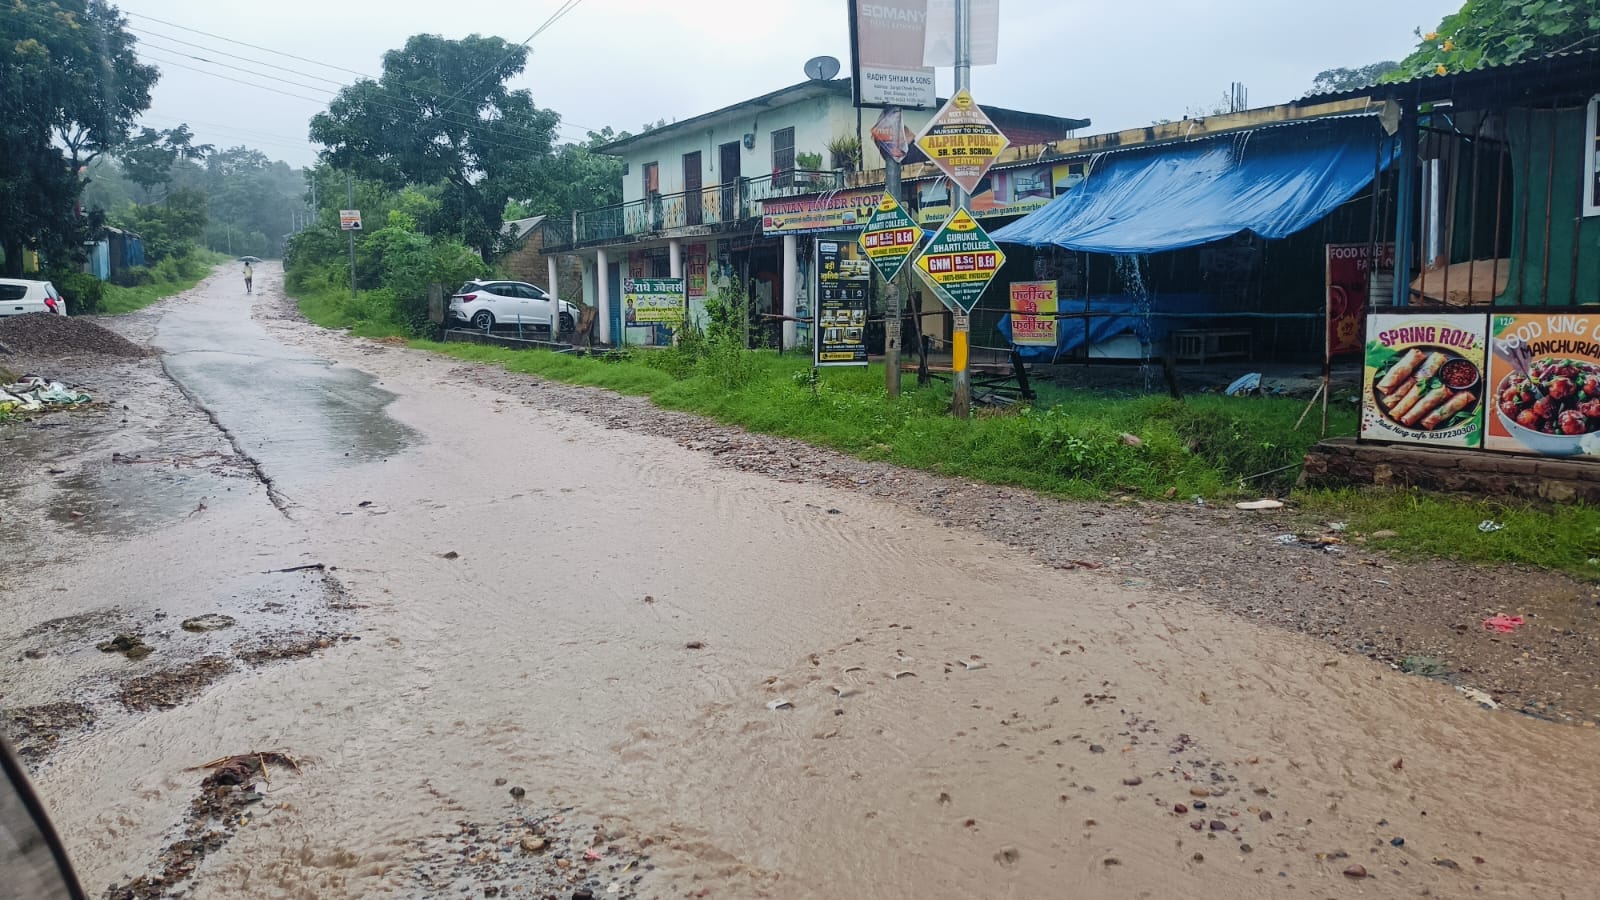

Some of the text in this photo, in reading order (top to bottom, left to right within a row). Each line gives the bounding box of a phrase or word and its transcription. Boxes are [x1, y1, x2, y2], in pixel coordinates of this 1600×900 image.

[862, 4, 927, 21] SOMANY
[866, 73, 887, 81] RADHY
[928, 135, 999, 148] ALPHA PUBLIC
[969, 147, 992, 155] SCHOOL
[763, 203, 804, 216] DHIMAN
[808, 199, 848, 211] TIMBER
[987, 207, 998, 215] with
[885, 219, 908, 228] COLLEGE
[897, 232, 912, 243] B.Ed
[946, 233, 978, 242] GURUKUL
[934, 241, 991, 253] BHARTI COLLEGE
[1331, 248, 1358, 258] FOOD
[930, 256, 995, 271] GNM B.Sc B.Ed
[634, 282, 650, 292] राधे
[1012, 287, 1052, 299] फर्नीचर
[1013, 316, 1053, 329] फर्नीचर
[1500, 317, 1514, 325] 120
[1379, 326, 1436, 347] SPRING
[1439, 328, 1475, 350] ROLL
[1497, 321, 1542, 355] FOOD
[1547, 316, 1588, 335] KING
[1393, 426, 1409, 437] King
